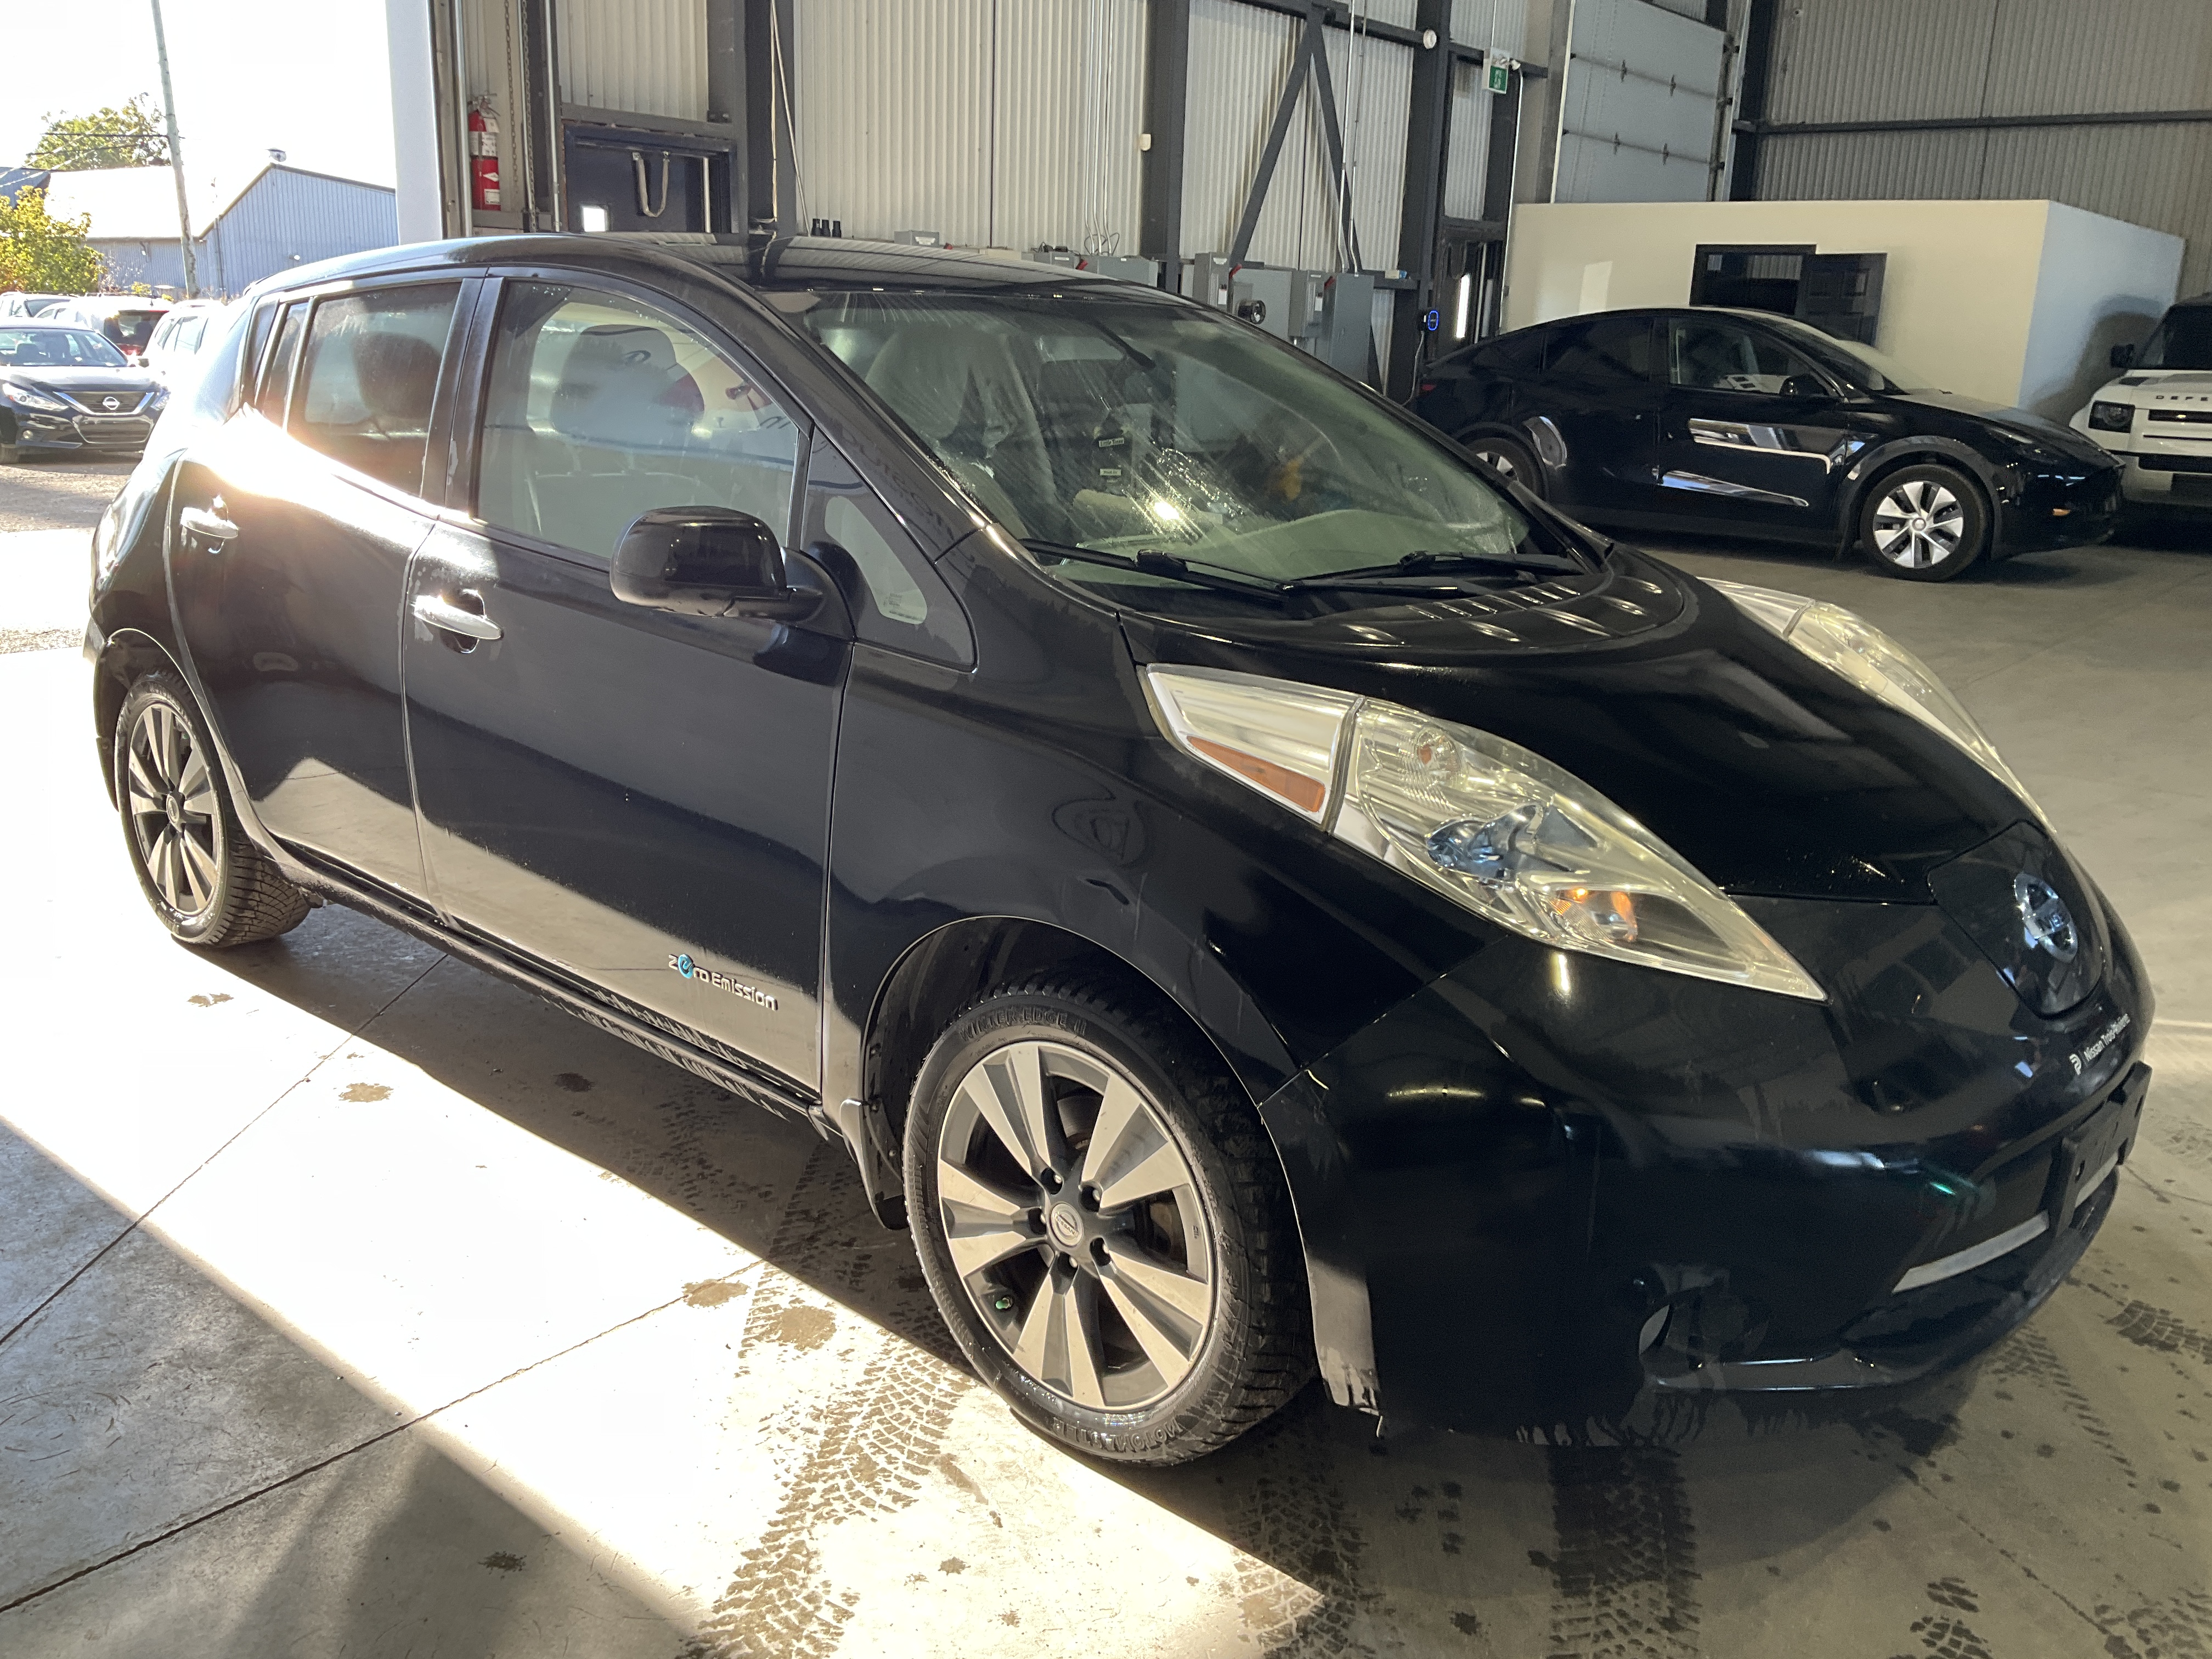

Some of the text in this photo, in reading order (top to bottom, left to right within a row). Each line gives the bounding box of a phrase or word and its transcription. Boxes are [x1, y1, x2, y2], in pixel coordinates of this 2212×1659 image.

[711, 972, 779, 1011] Emission
[960, 1006, 1018, 1042] WINTER
[1022, 1006, 1068, 1028] EDGE
[2084, 1040, 2106, 1062] Nissan
[1055, 1215, 1076, 1235] NISSAN
[1052, 1416, 1184, 1453] MOTOMASTER
